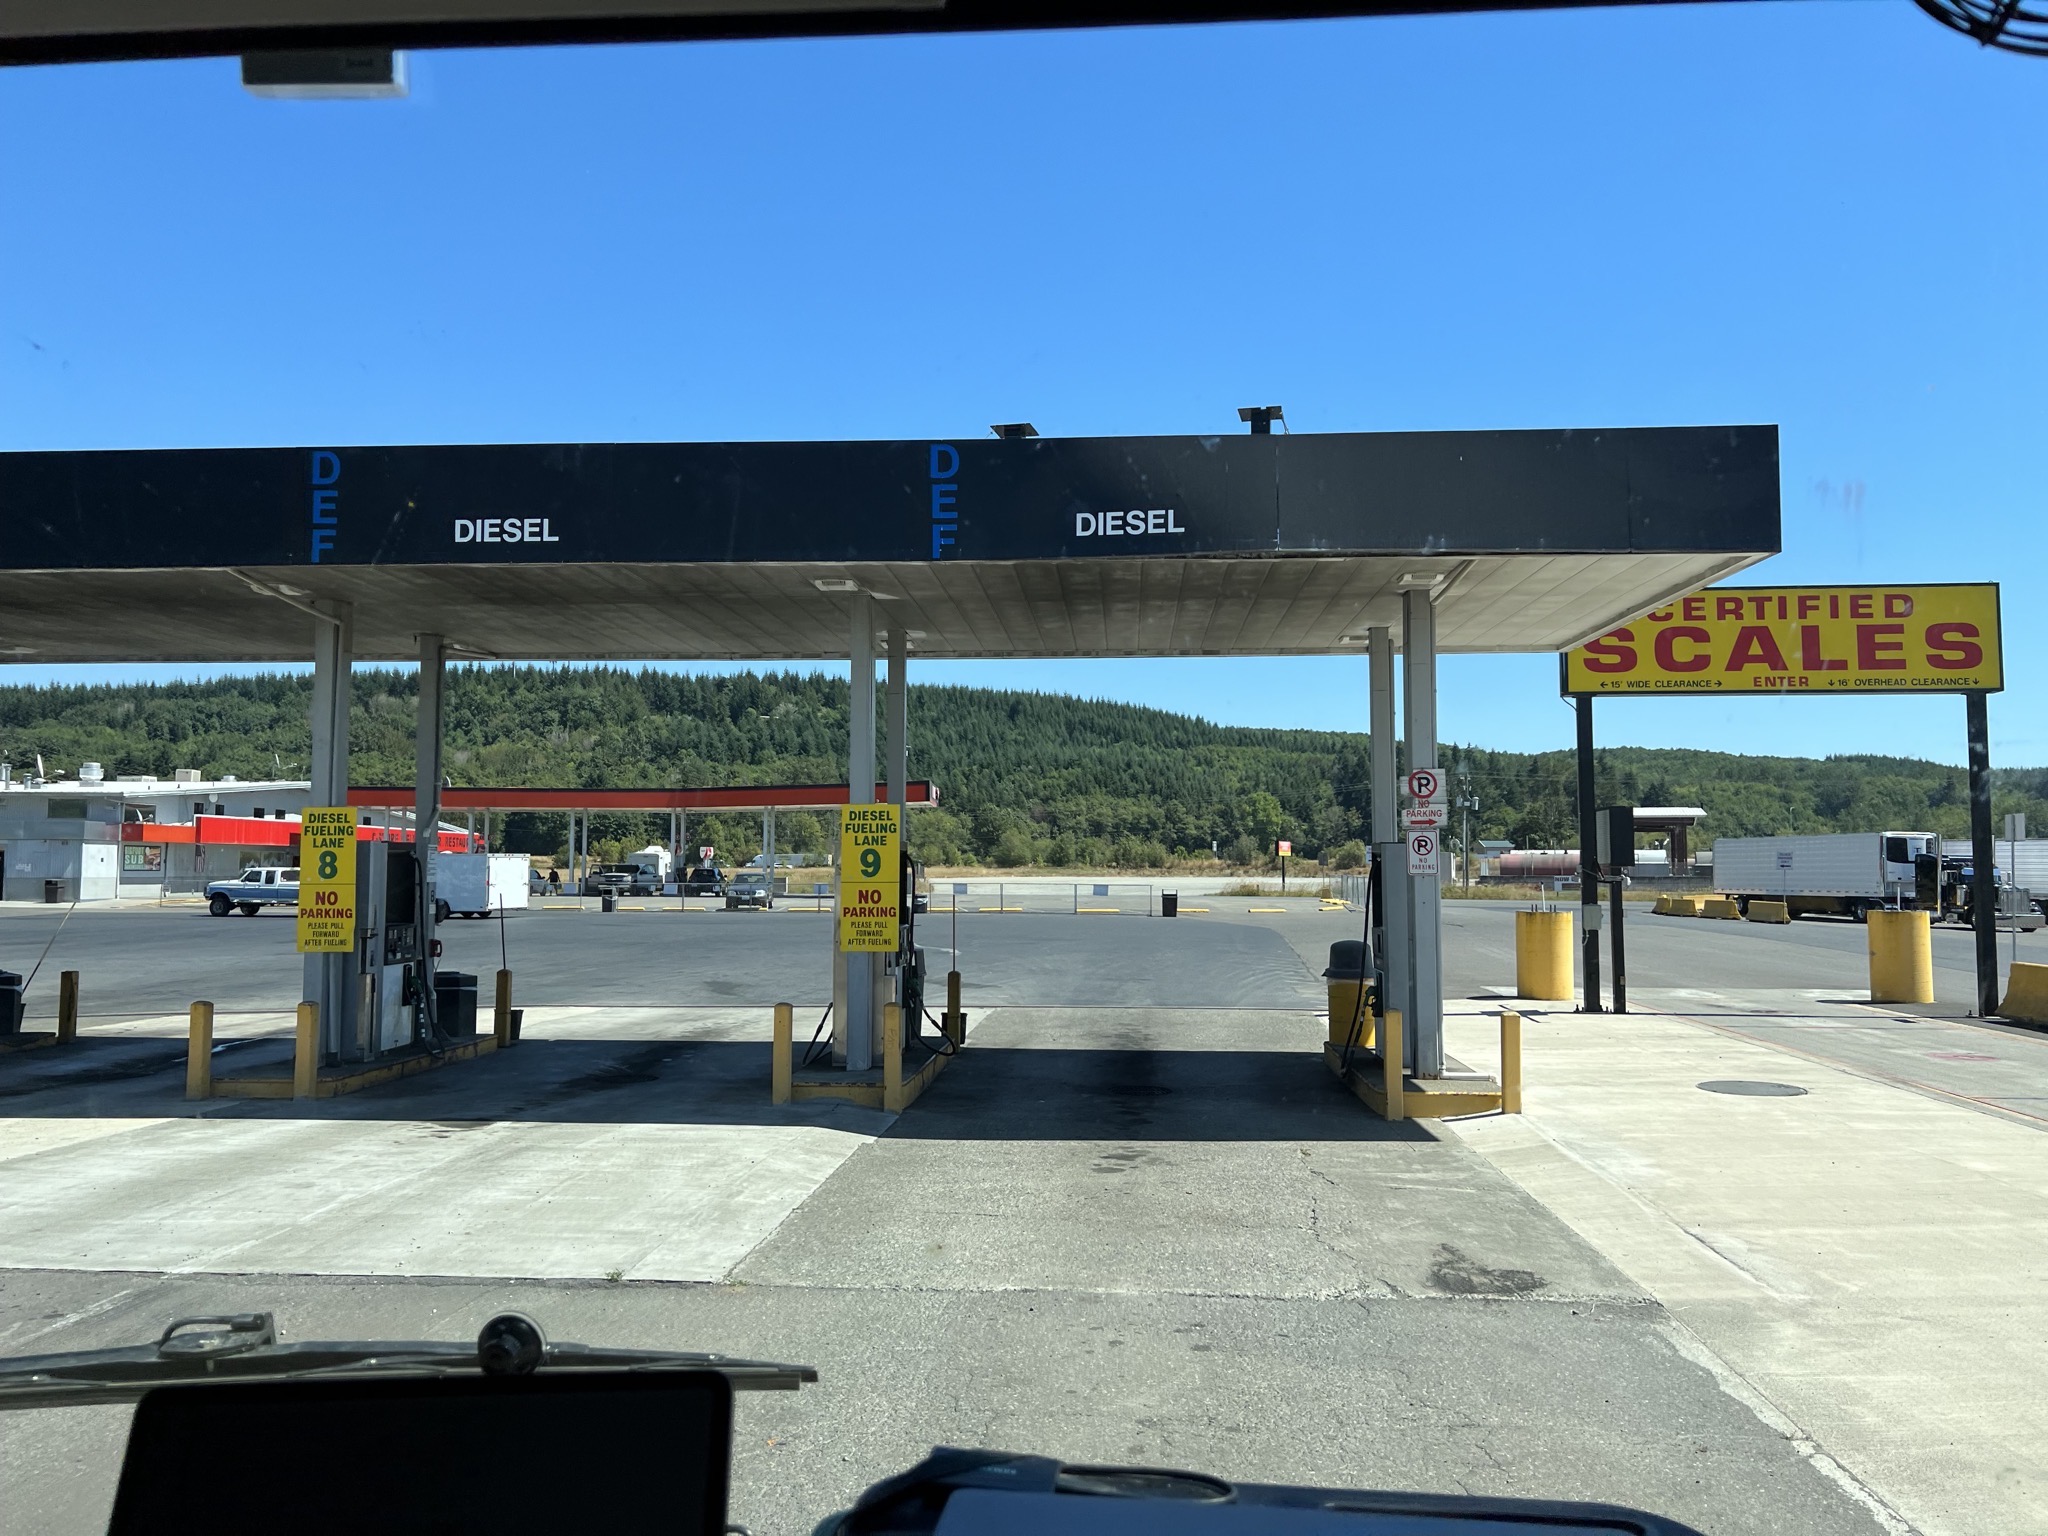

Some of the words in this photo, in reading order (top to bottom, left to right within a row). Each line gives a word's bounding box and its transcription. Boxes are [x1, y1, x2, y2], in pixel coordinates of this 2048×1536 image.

[311, 450, 341, 563] DEF
[929, 443, 960, 559] DEF
[1075, 509, 1185, 537] DIESEL
[454, 518, 560, 543] DIESEL
[1583, 622, 1983, 674] SCALES
[1611, 680, 1623, 688] 15'
[1626, 680, 1650, 688] WIDE
[1654, 680, 1712, 688] CLEARANCE
[1753, 676, 1809, 688] ENTER
[1837, 679, 1850, 687] 16'
[1854, 678, 1907, 687] OVERHEAD
[1911, 677, 1970, 686] CLEARANCE
[1418, 800, 1430, 808] NO
[308, 813, 350, 824] DIESEL
[849, 810, 893, 821] DIESEL
[1406, 809, 1443, 818] PARKING
[304, 825, 354, 836] FUELING
[844, 823, 897, 834] FUELING
[312, 837, 345, 849] LANE
[854, 835, 888, 846] LANE
[124, 855, 144, 864] SUB
[318, 850, 338, 880] 8
[860, 848, 881, 878] 9
[315, 891, 339, 906] NO
[857, 889, 882, 905] NO
[300, 908, 353, 919] PARKING
[843, 906, 897, 918] PARKING
[307, 922, 328, 930] PLEASE
[330, 922, 345, 930] PULL
[850, 921, 872, 929] PLEASE
[312, 930, 340, 938] FORWARD
[855, 929, 883, 937] FORWARD
[304, 938, 322, 946] AFTER
[323, 938, 348, 946] FUELING
[847, 938, 866, 946] AFTER
[867, 938, 892, 946] FUELING
